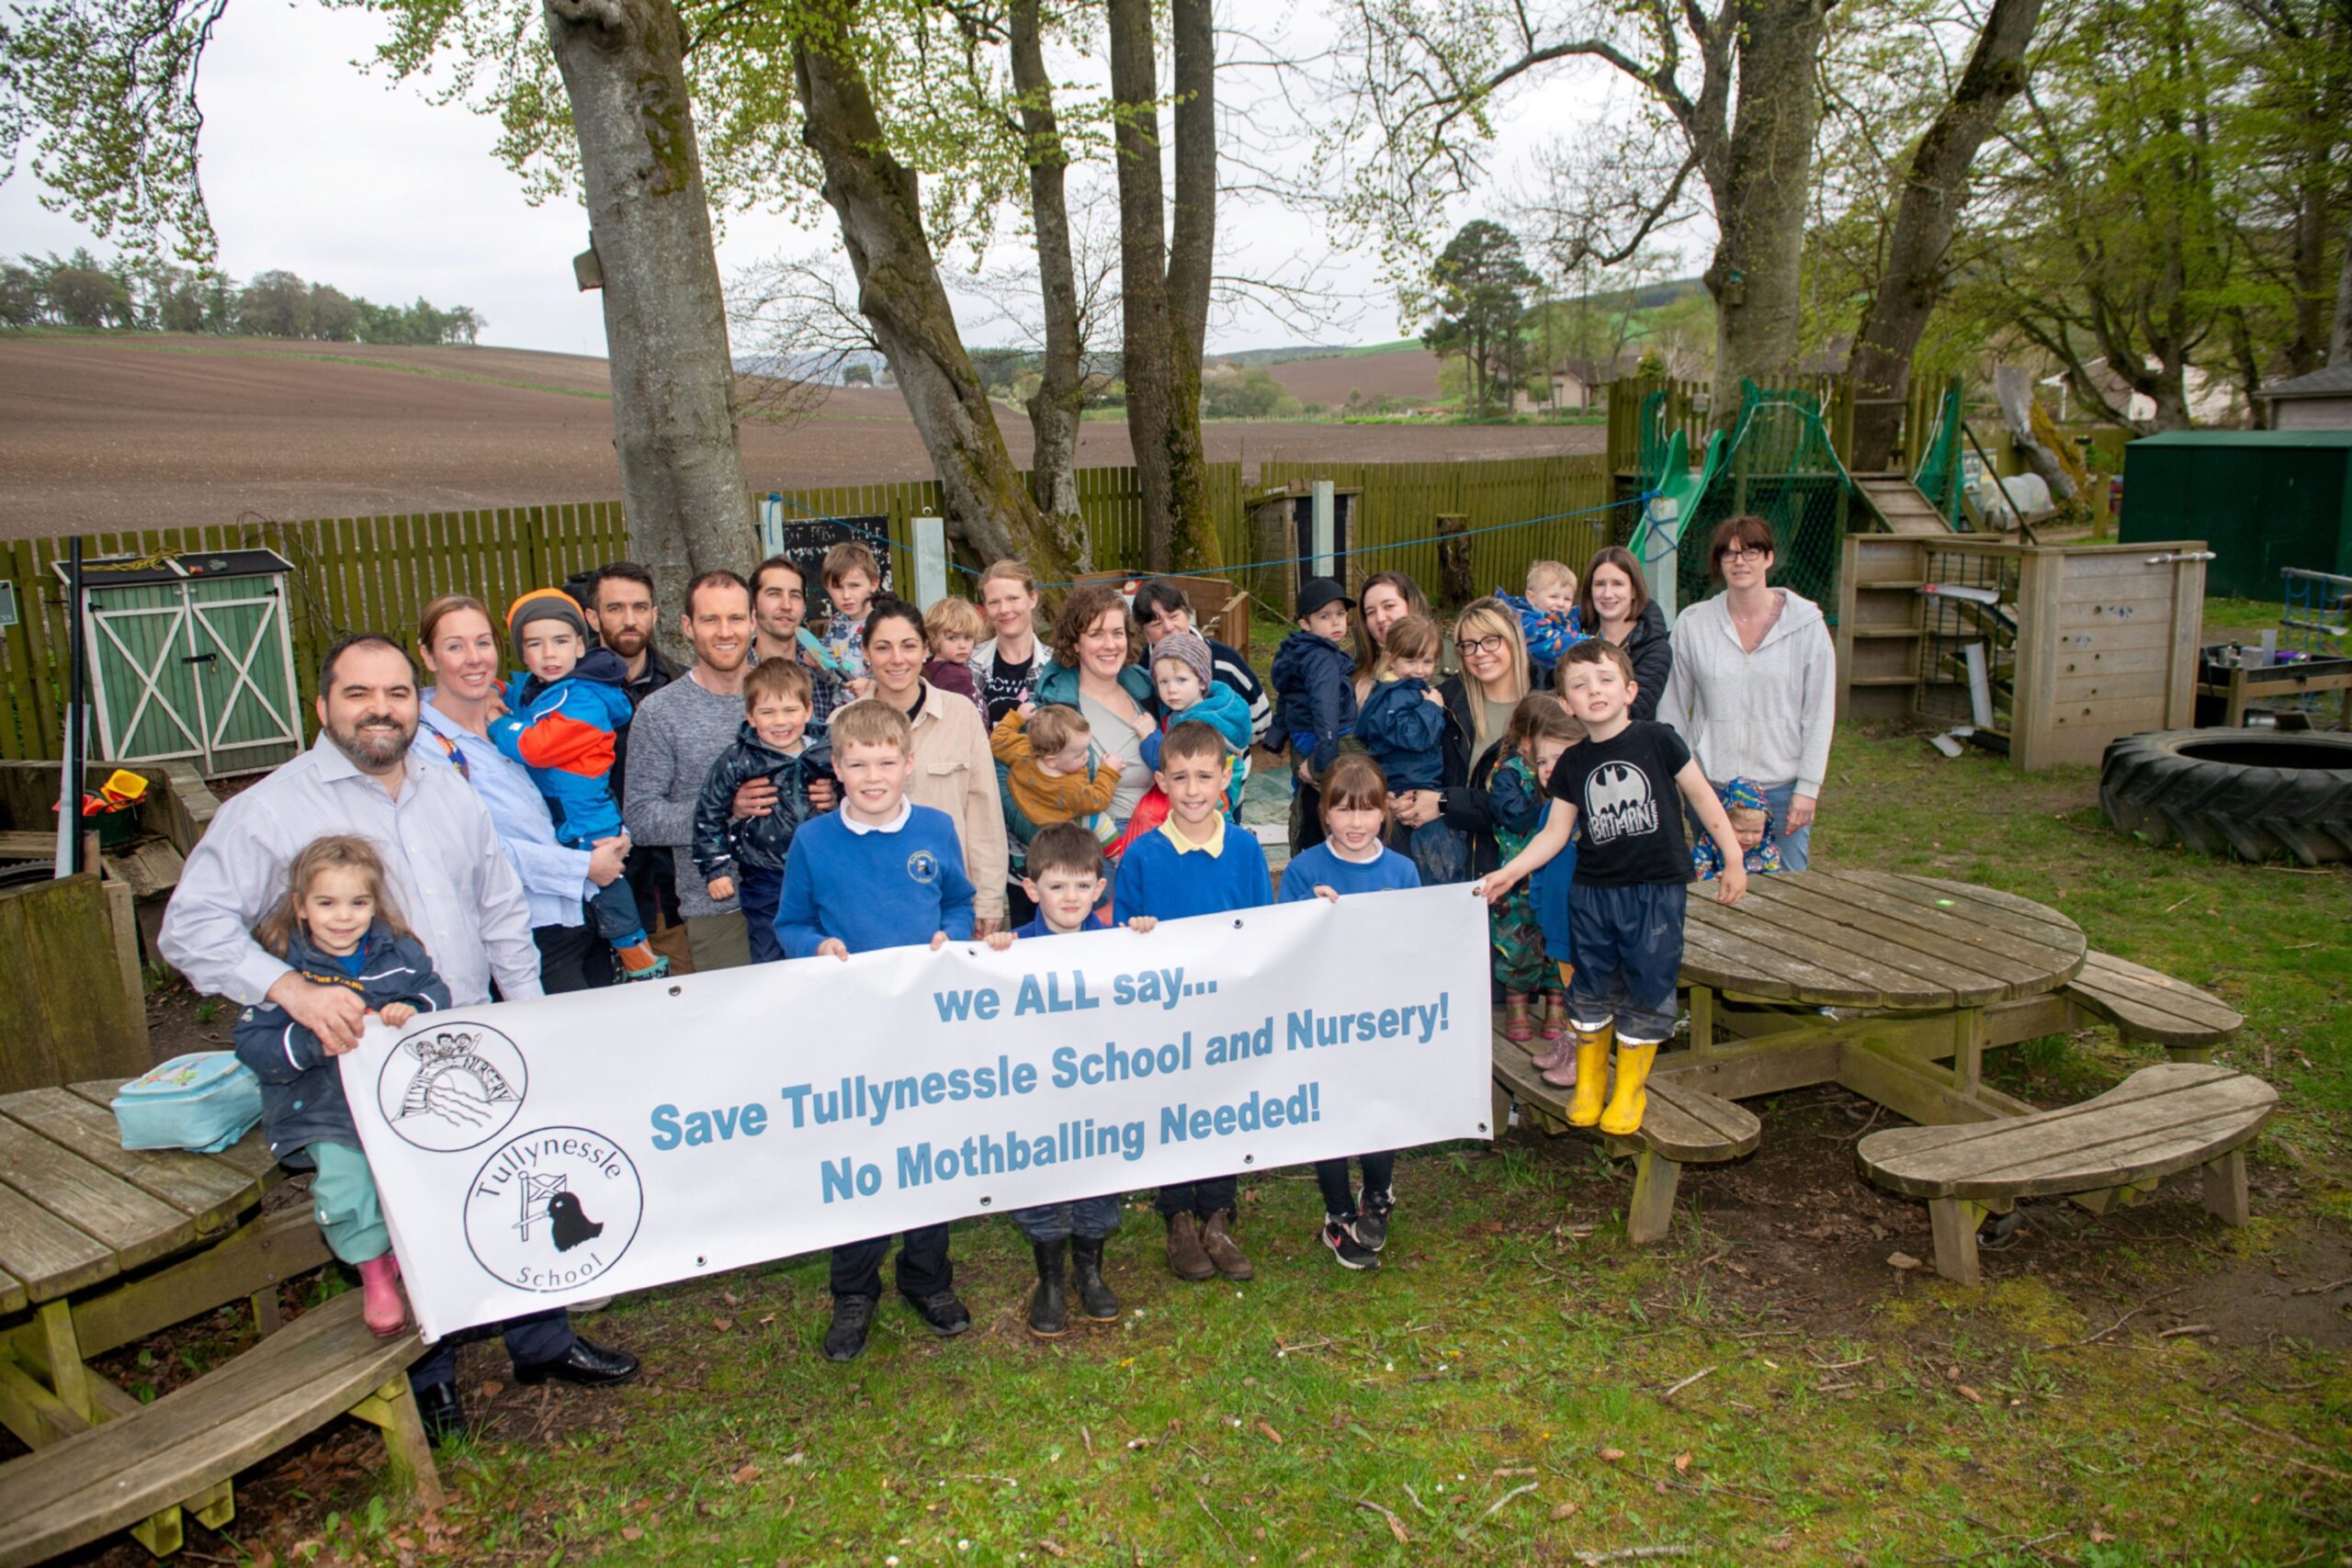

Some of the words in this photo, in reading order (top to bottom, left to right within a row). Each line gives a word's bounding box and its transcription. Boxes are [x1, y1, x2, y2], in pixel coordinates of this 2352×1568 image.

[1590, 804, 1653, 840] BATMAN
[934, 988, 1001, 1022] we
[1014, 970, 1100, 1016] ALL
[1114, 966, 1217, 1010] say...
[650, 1101, 768, 1152] Save
[781, 1054, 1037, 1129] Tullynessle
[1052, 1032, 1192, 1089] School
[1204, 1016, 1274, 1066] and
[1287, 991, 1449, 1052] Nursery!
[476, 1137, 622, 1198] Tullynessle
[821, 1156, 882, 1204] No
[896, 1119, 1145, 1190] Mothballing
[1160, 1082, 1321, 1145] Needed!
[516, 1252, 603, 1287] School
